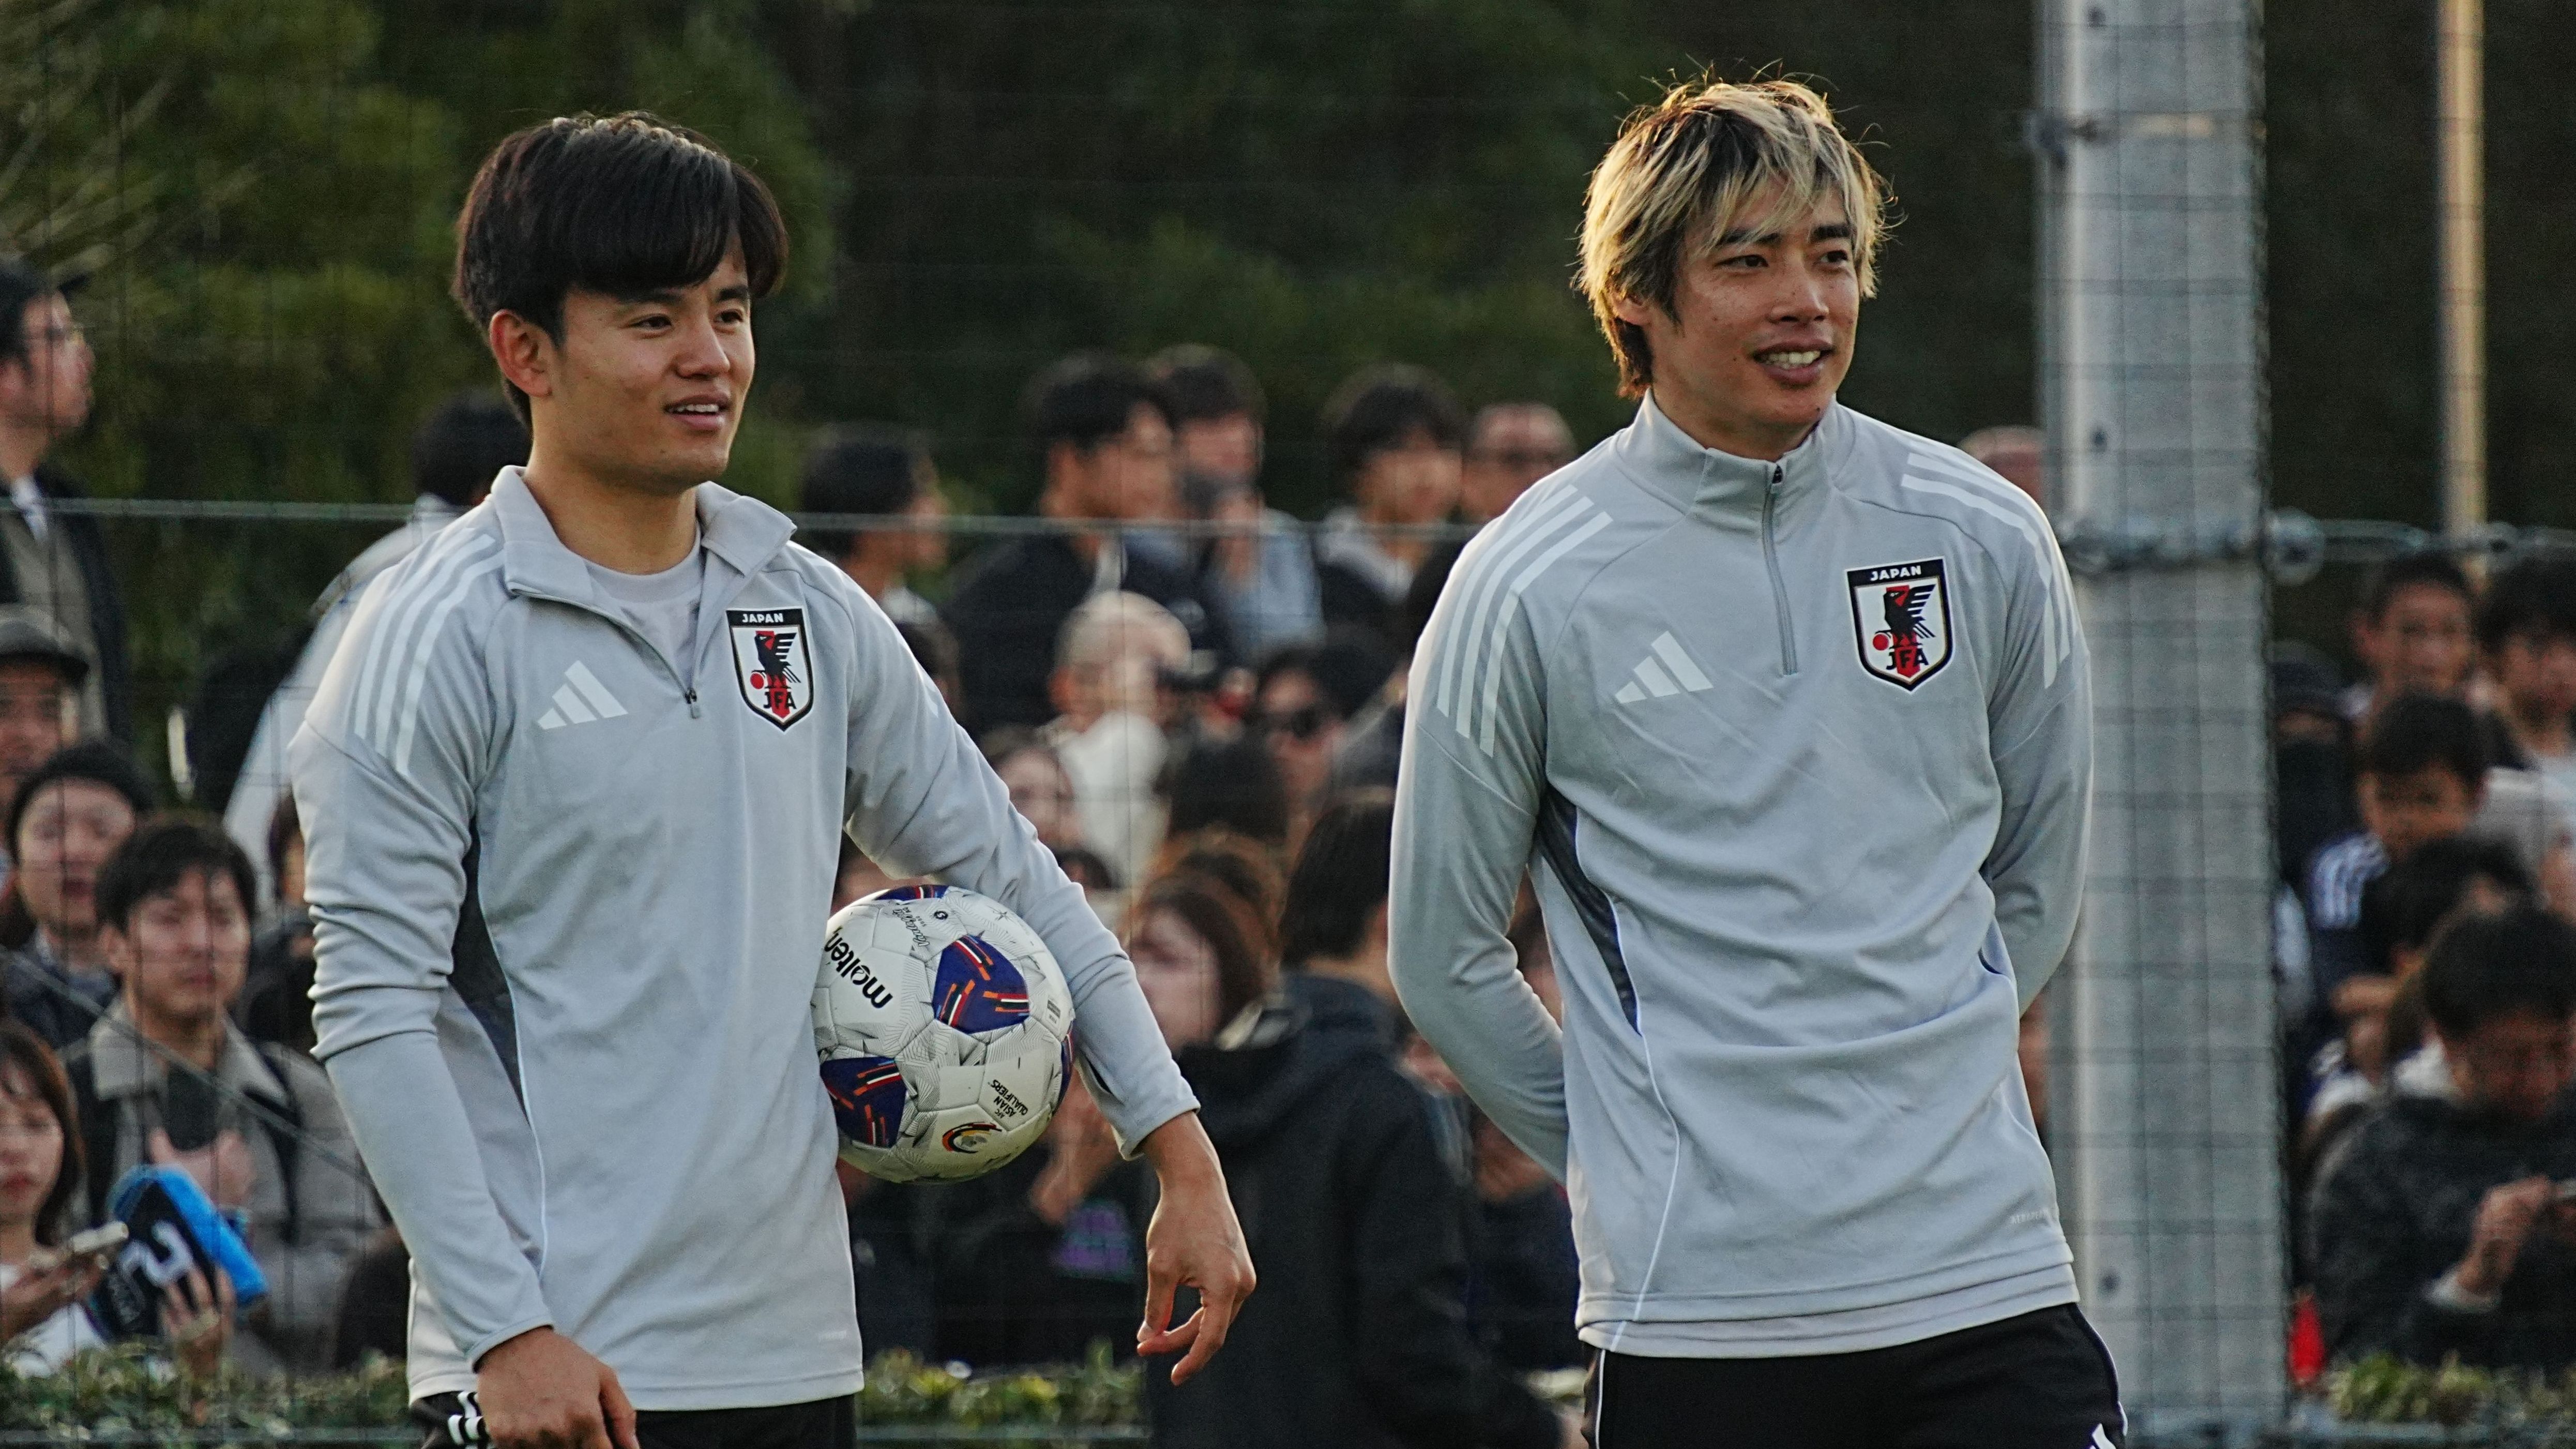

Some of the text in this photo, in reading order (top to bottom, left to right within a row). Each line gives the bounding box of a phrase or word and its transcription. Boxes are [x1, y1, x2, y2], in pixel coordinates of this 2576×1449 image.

[1871, 566, 1921, 581] JAPAN
[742, 613, 784, 623] JAPAN
[1886, 648, 1929, 670] JFA
[763, 691, 797, 709] JFA
[824, 932, 893, 1008] molten
[990, 1079, 1028, 1115] QUALIFIERS
[993, 1096, 1017, 1117] ASIAN
[994, 1109, 1005, 1119] AFC
